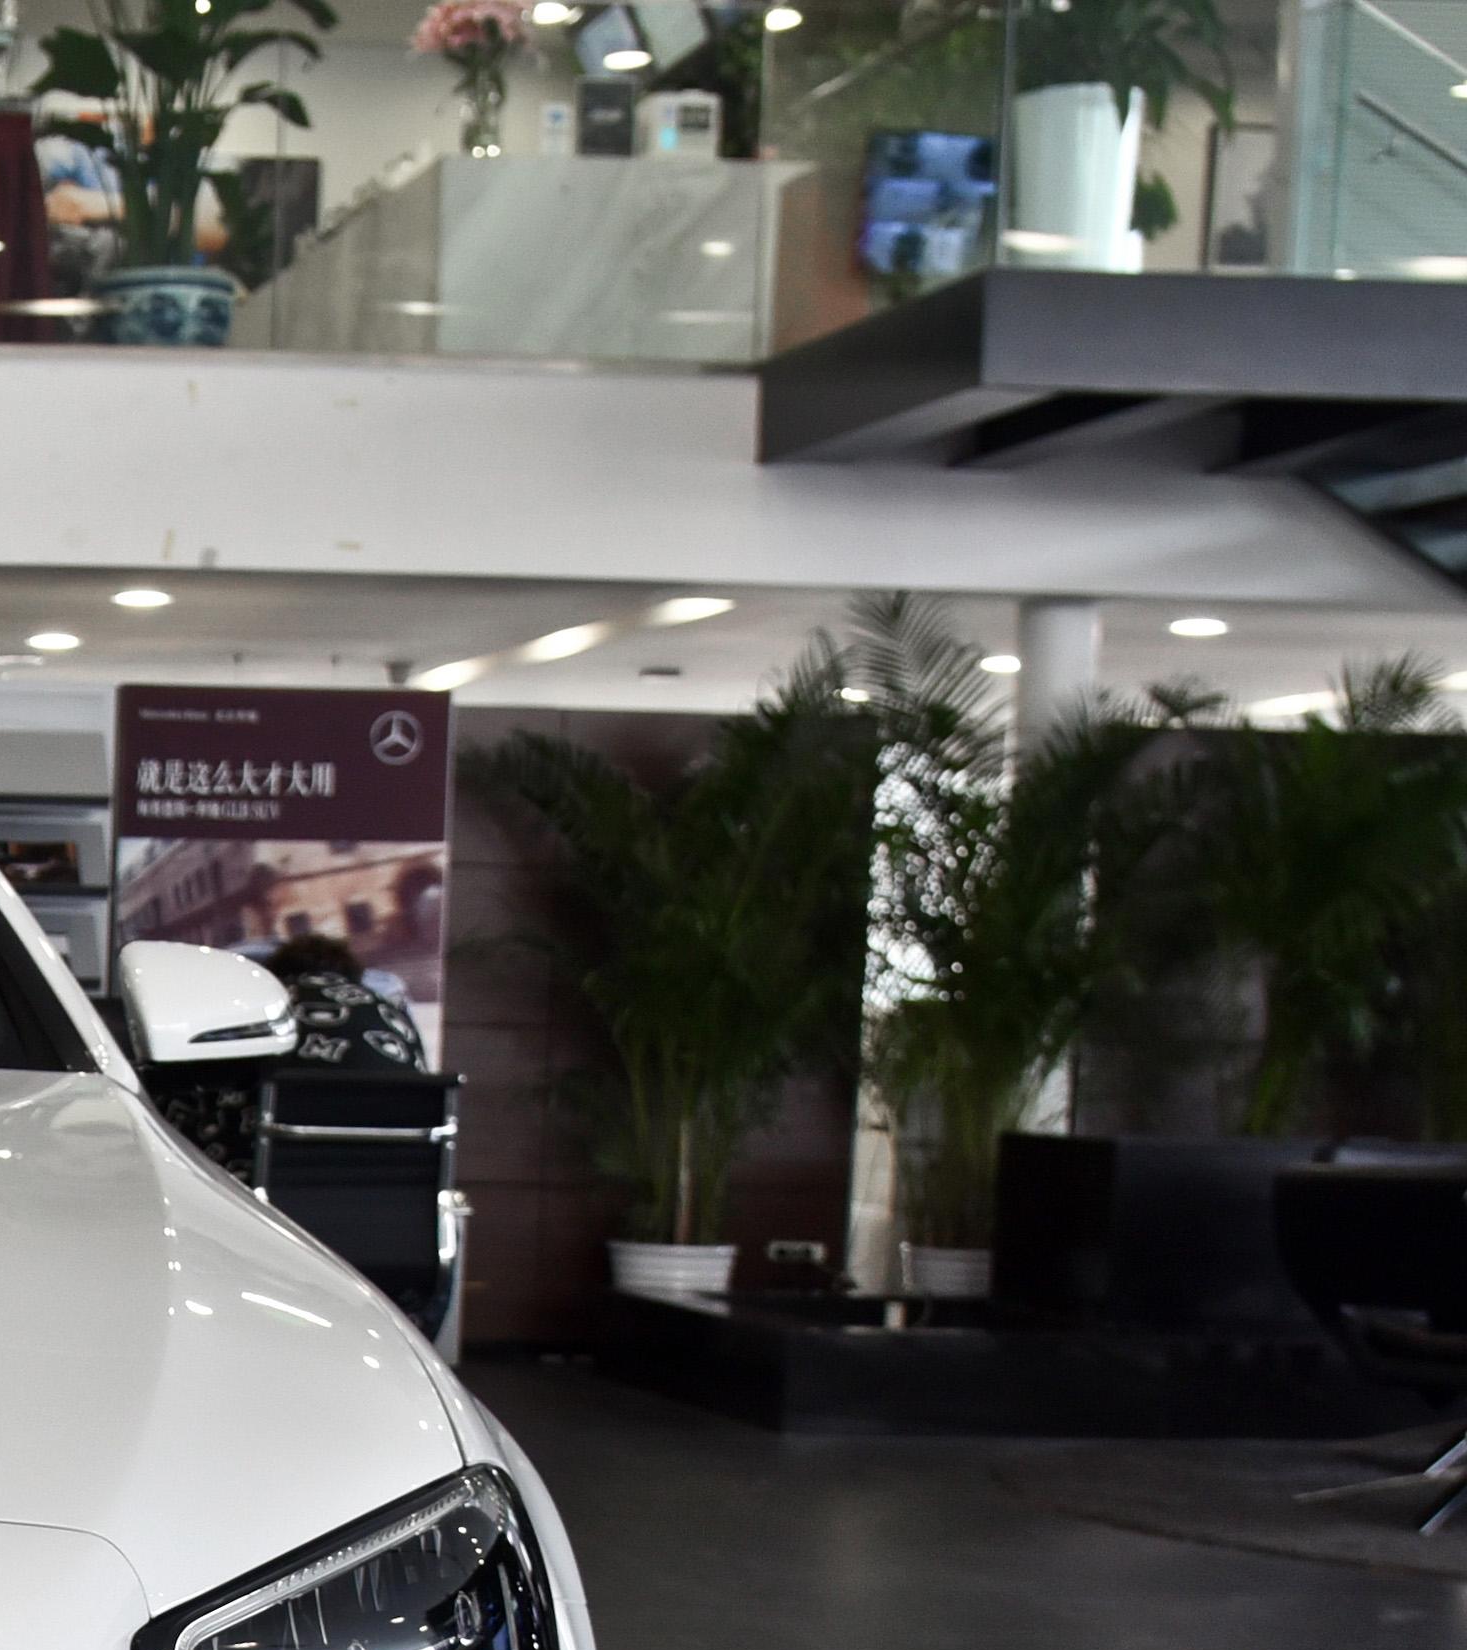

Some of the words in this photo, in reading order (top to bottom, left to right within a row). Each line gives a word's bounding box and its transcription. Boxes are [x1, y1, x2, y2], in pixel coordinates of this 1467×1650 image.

[136, 757, 336, 797] 就是这么大才大用
